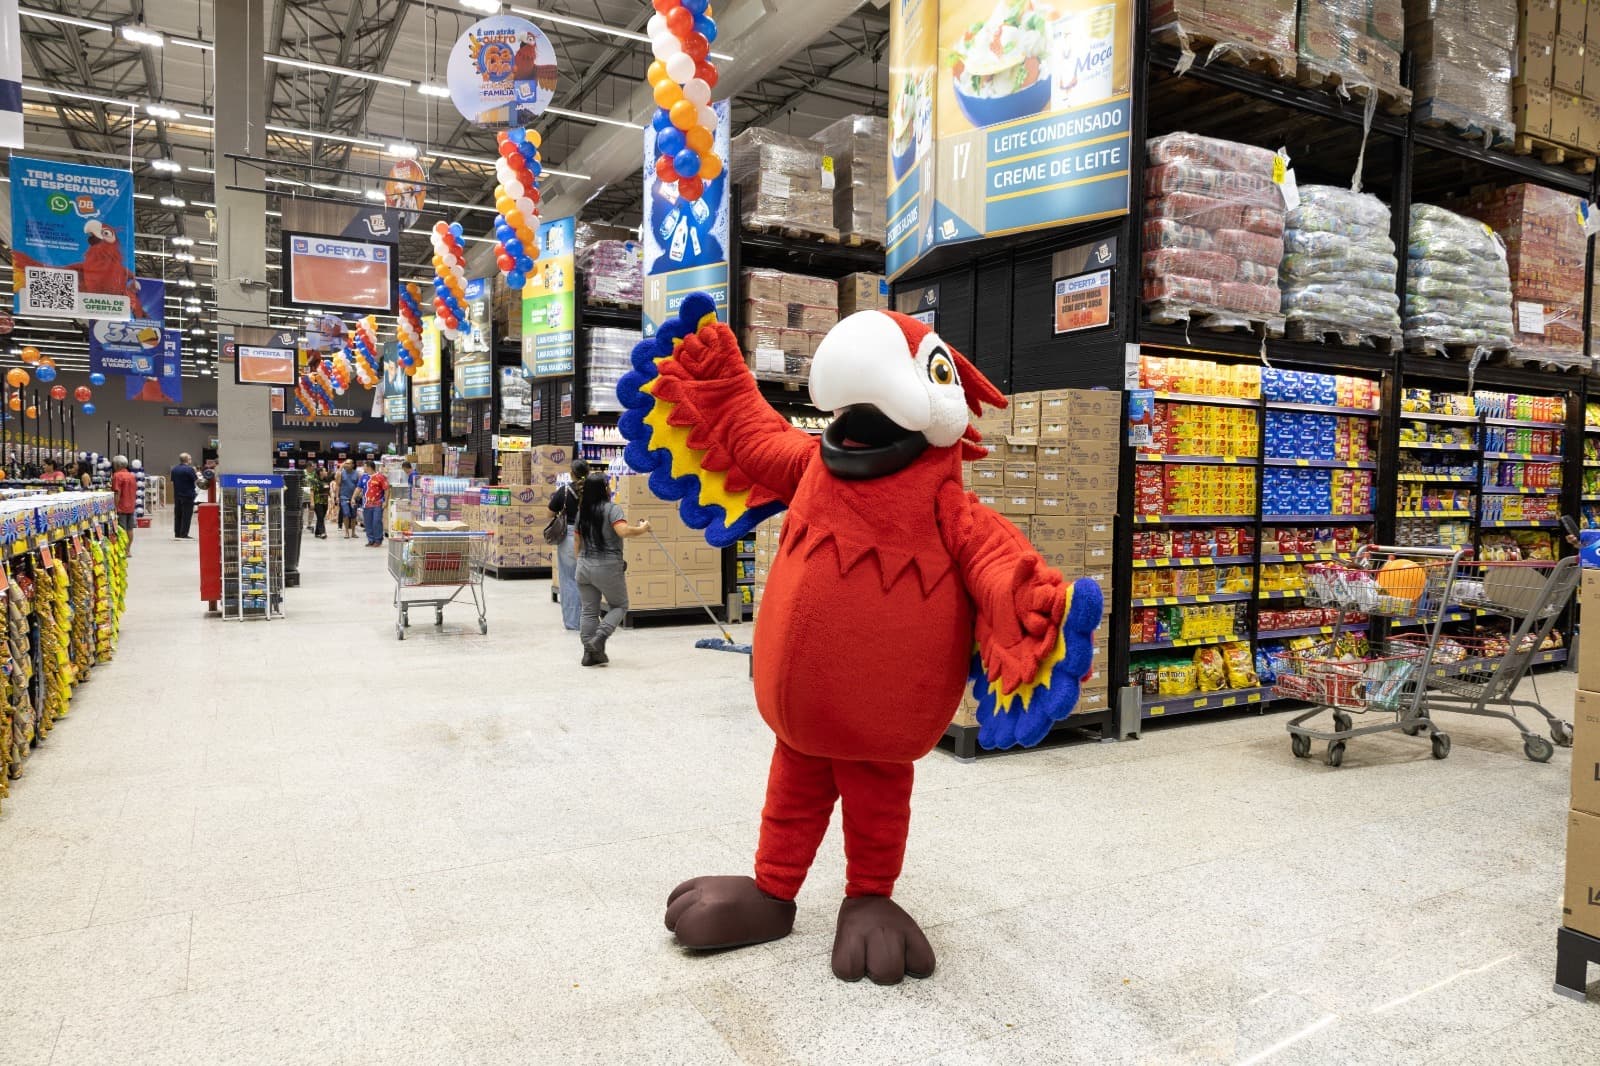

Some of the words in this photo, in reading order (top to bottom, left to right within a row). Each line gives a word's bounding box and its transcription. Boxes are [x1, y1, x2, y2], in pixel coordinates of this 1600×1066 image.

[484, 35, 516, 44] outro
[496, 28, 515, 36] atrás
[1075, 45, 1112, 73] Moça
[994, 131, 1028, 153] LEITE
[1030, 109, 1122, 145] CONDENSADO
[953, 142, 971, 181] 17
[994, 163, 1046, 189] CREME
[1050, 157, 1072, 177] DE
[1075, 147, 1121, 172] LEITE
[26, 169, 53, 181] TEM
[56, 173, 117, 188] SORTEIOS
[924, 158, 931, 194] 16
[21, 177, 38, 187] TE
[41, 180, 120, 197] ESPERANDO!
[315, 243, 366, 259] OFERTA
[651, 280, 660, 302] 16
[1068, 277, 1096, 290] OFERTA
[83, 298, 111, 306] CANAL
[85, 304, 122, 312] OFERTAS
[328, 408, 355, 417] LETRO
[551, 451, 565, 461] VEJA
[520, 491, 534, 501] VEJA
